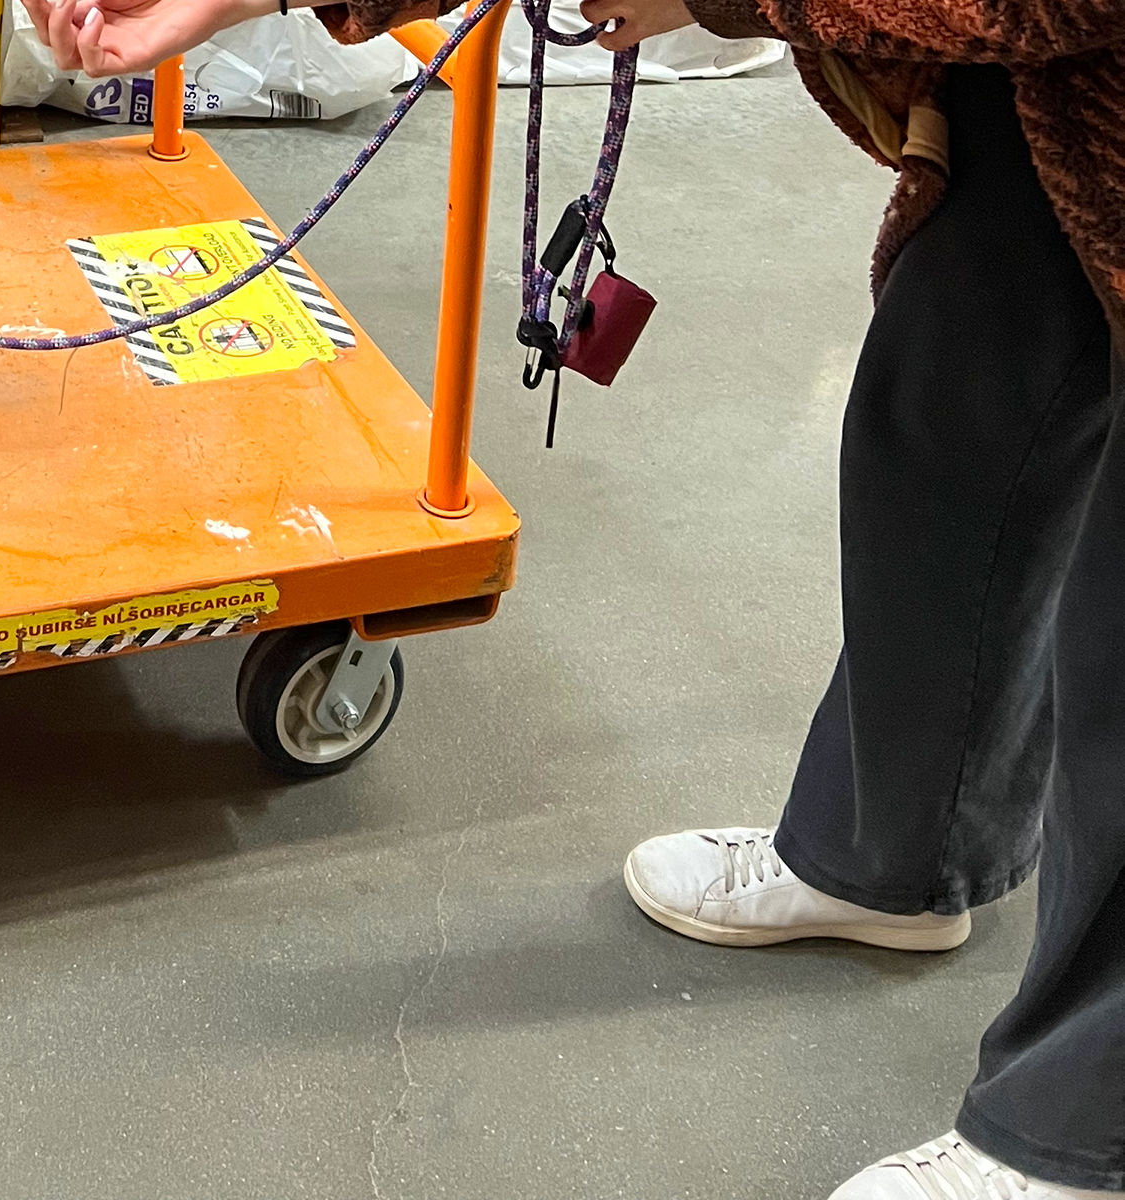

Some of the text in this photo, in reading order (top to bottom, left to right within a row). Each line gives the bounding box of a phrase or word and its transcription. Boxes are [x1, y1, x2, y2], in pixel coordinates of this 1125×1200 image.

[133, 93, 148, 123] CED
[126, 270, 195, 356] CATIO
[15, 615, 97, 640] SUBIRSE
[127, 591, 265, 622] SOBRECARGAR
